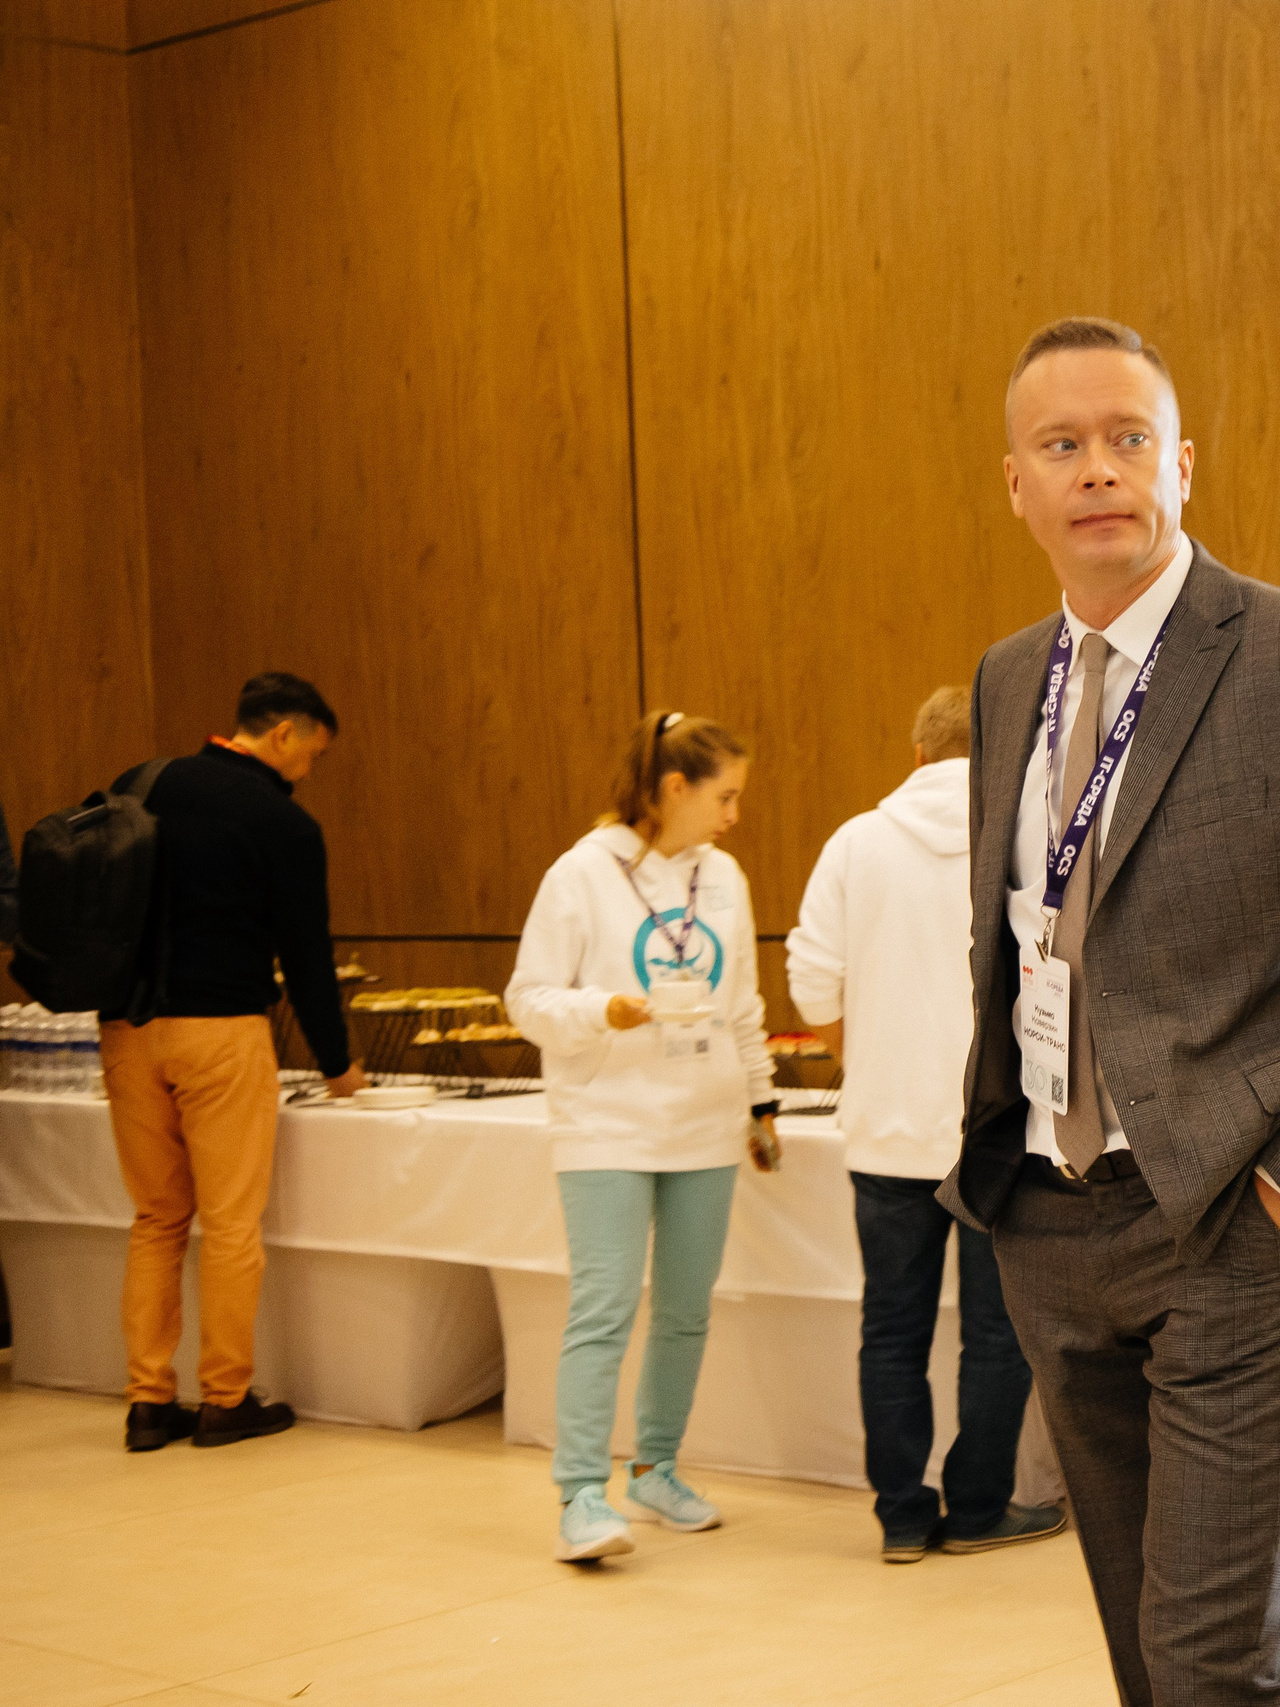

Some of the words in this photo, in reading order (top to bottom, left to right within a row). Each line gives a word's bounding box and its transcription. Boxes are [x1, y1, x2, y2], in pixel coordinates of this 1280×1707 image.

[1048, 662, 1066, 733] IT-СРЕДА
[1113, 709, 1136, 742] OCS
[1074, 756, 1114, 827] IT-СРЕДА
[1056, 844, 1077, 876] OCS
